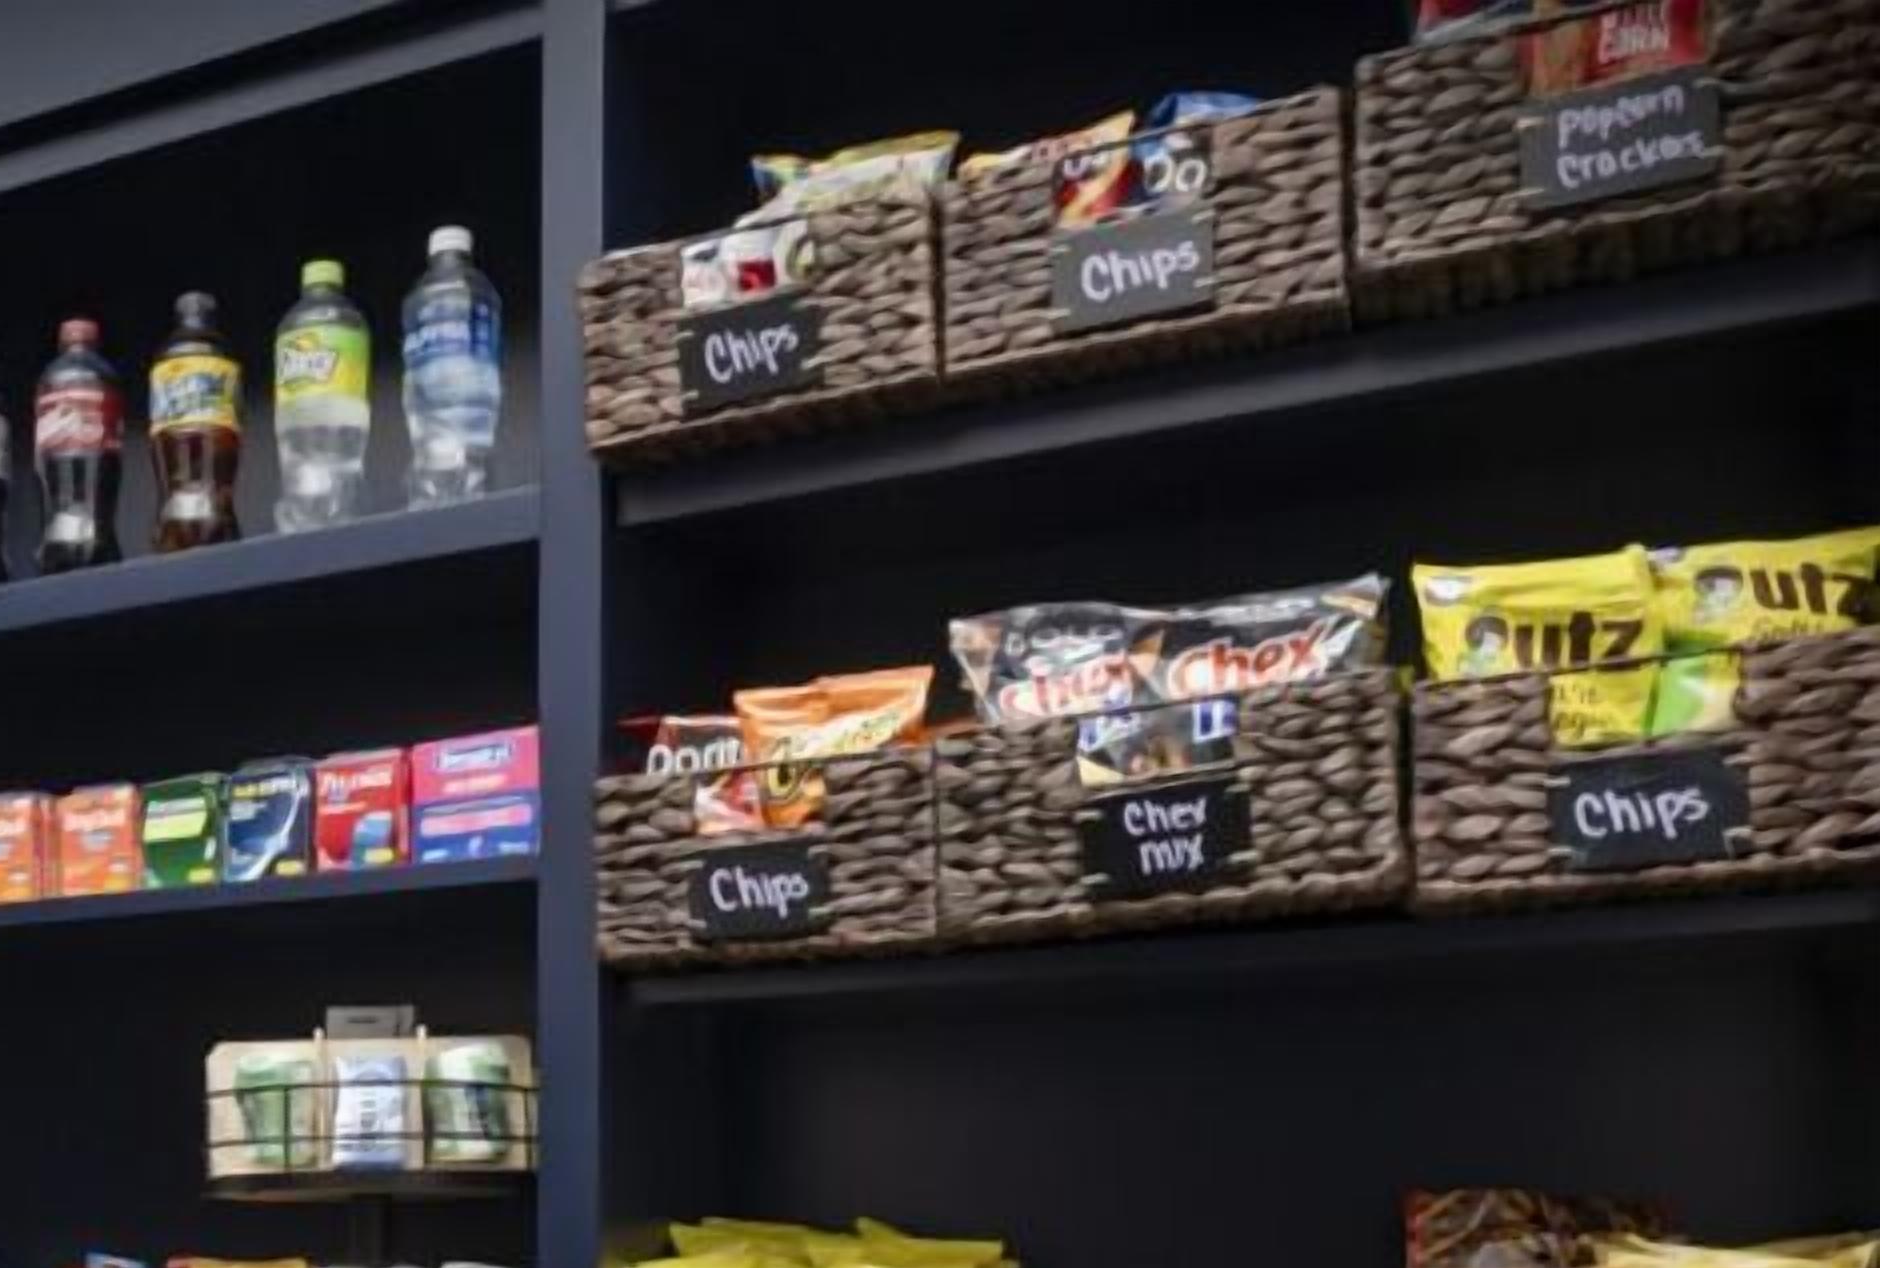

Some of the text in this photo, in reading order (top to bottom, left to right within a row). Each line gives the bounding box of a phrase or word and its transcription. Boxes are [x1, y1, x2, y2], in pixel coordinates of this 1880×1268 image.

[1080, 240, 1200, 301] Chips
[704, 321, 800, 384] Chips
[1168, 616, 1335, 699] Chex
[1123, 796, 1208, 837] Chex
[1573, 787, 1710, 839] Chips
[709, 865, 810, 919] Chips
